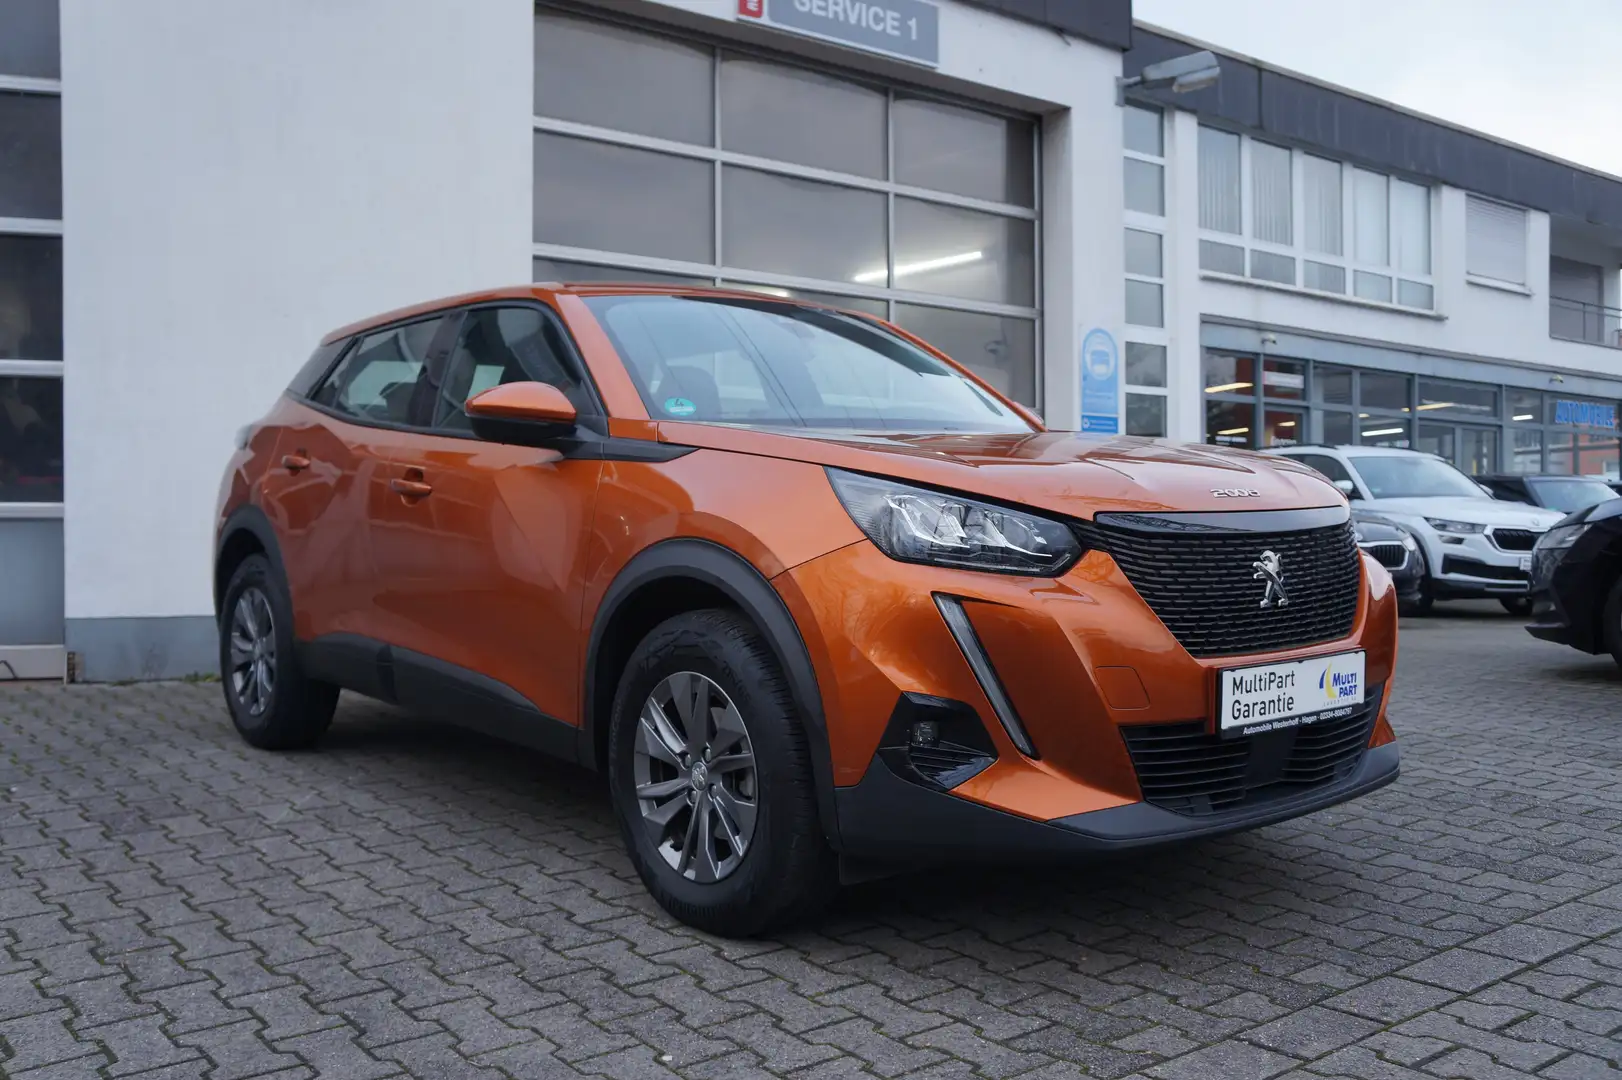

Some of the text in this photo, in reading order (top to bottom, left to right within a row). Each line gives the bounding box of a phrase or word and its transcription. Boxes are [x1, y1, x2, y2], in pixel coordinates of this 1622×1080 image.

[907, 17, 917, 40] 1
[1210, 488, 1261, 498] 2008
[1232, 670, 1295, 696] MultiPart
[1339, 684, 1357, 698] PART
[1231, 692, 1294, 720] Garantie
[1243, 723, 1272, 735] Automobile
